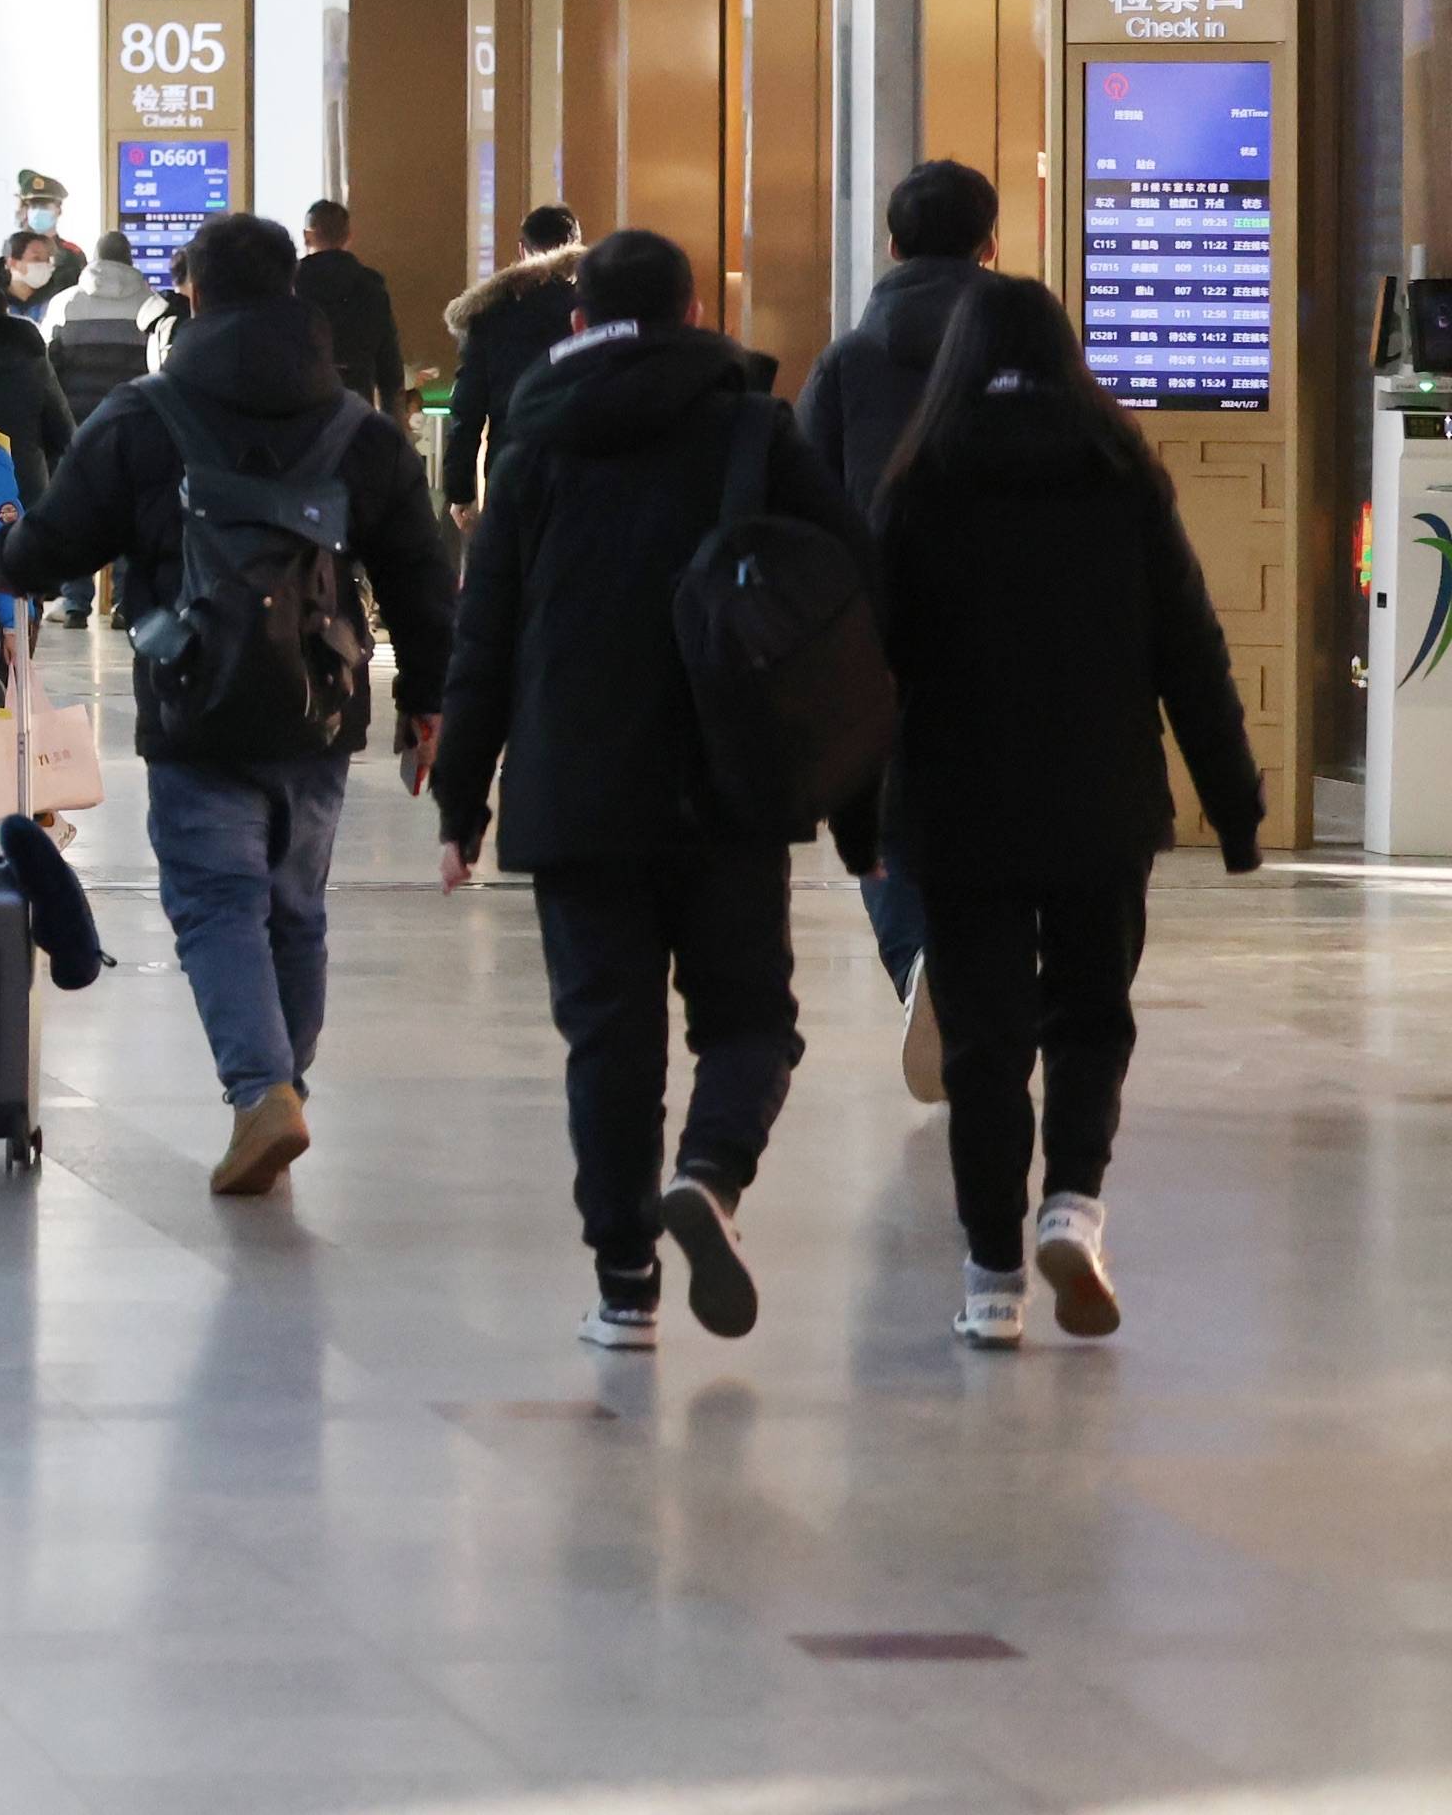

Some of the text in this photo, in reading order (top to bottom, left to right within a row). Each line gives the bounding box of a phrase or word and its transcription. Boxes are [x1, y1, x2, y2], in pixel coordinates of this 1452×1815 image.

[1125, 17, 1225, 38] Check in
[120, 22, 225, 74] 805
[132, 84, 215, 112] 检票口
[150, 149, 206, 166] D6601
[1095, 198, 1115, 208] 车次
[1205, 199, 1225, 209] 开点
[1093, 240, 1116, 249] C115
[1175, 240, 1192, 250] 809
[1202, 241, 1227, 250] 11:22
[1202, 287, 1227, 295] 12:22
[1202, 333, 1227, 342] 14:12
[1095, 377, 1119, 386] 7817
[1201, 378, 1226, 387] 15:24
